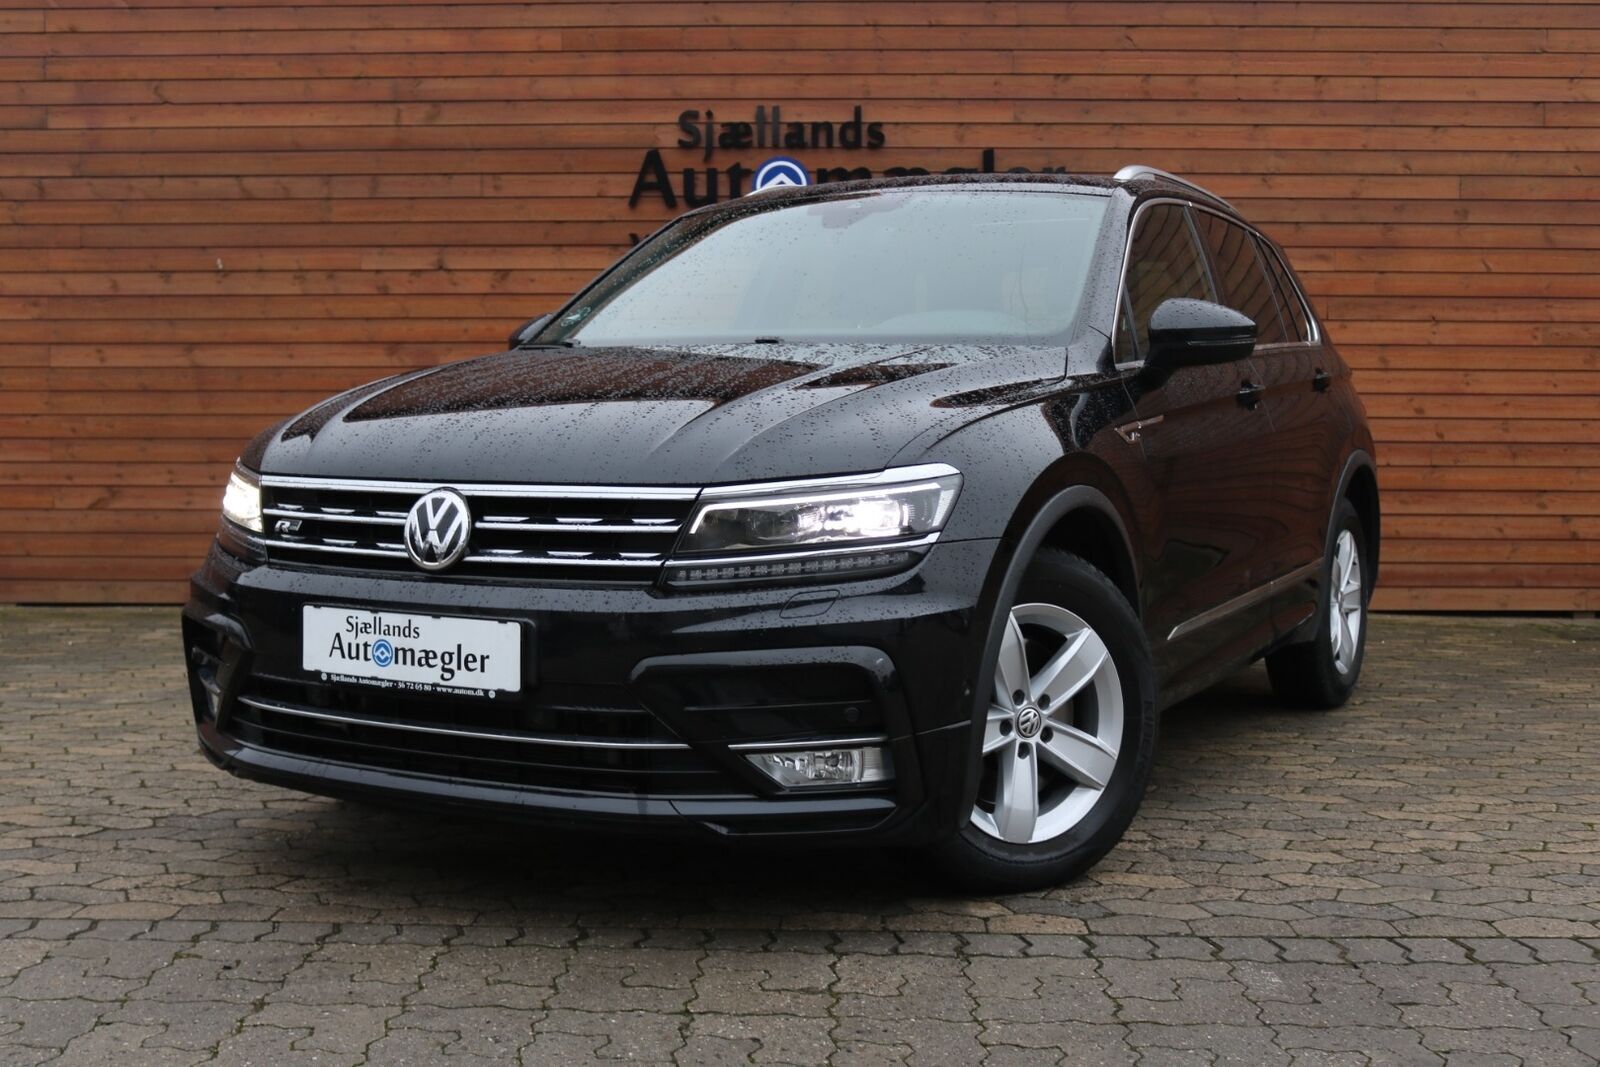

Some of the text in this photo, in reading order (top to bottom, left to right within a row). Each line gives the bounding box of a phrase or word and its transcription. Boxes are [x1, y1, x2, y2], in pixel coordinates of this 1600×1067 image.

[677, 105, 886, 163] Sjællands
[345, 615, 420, 639] Sjællands
[329, 632, 490, 681] Automægler
